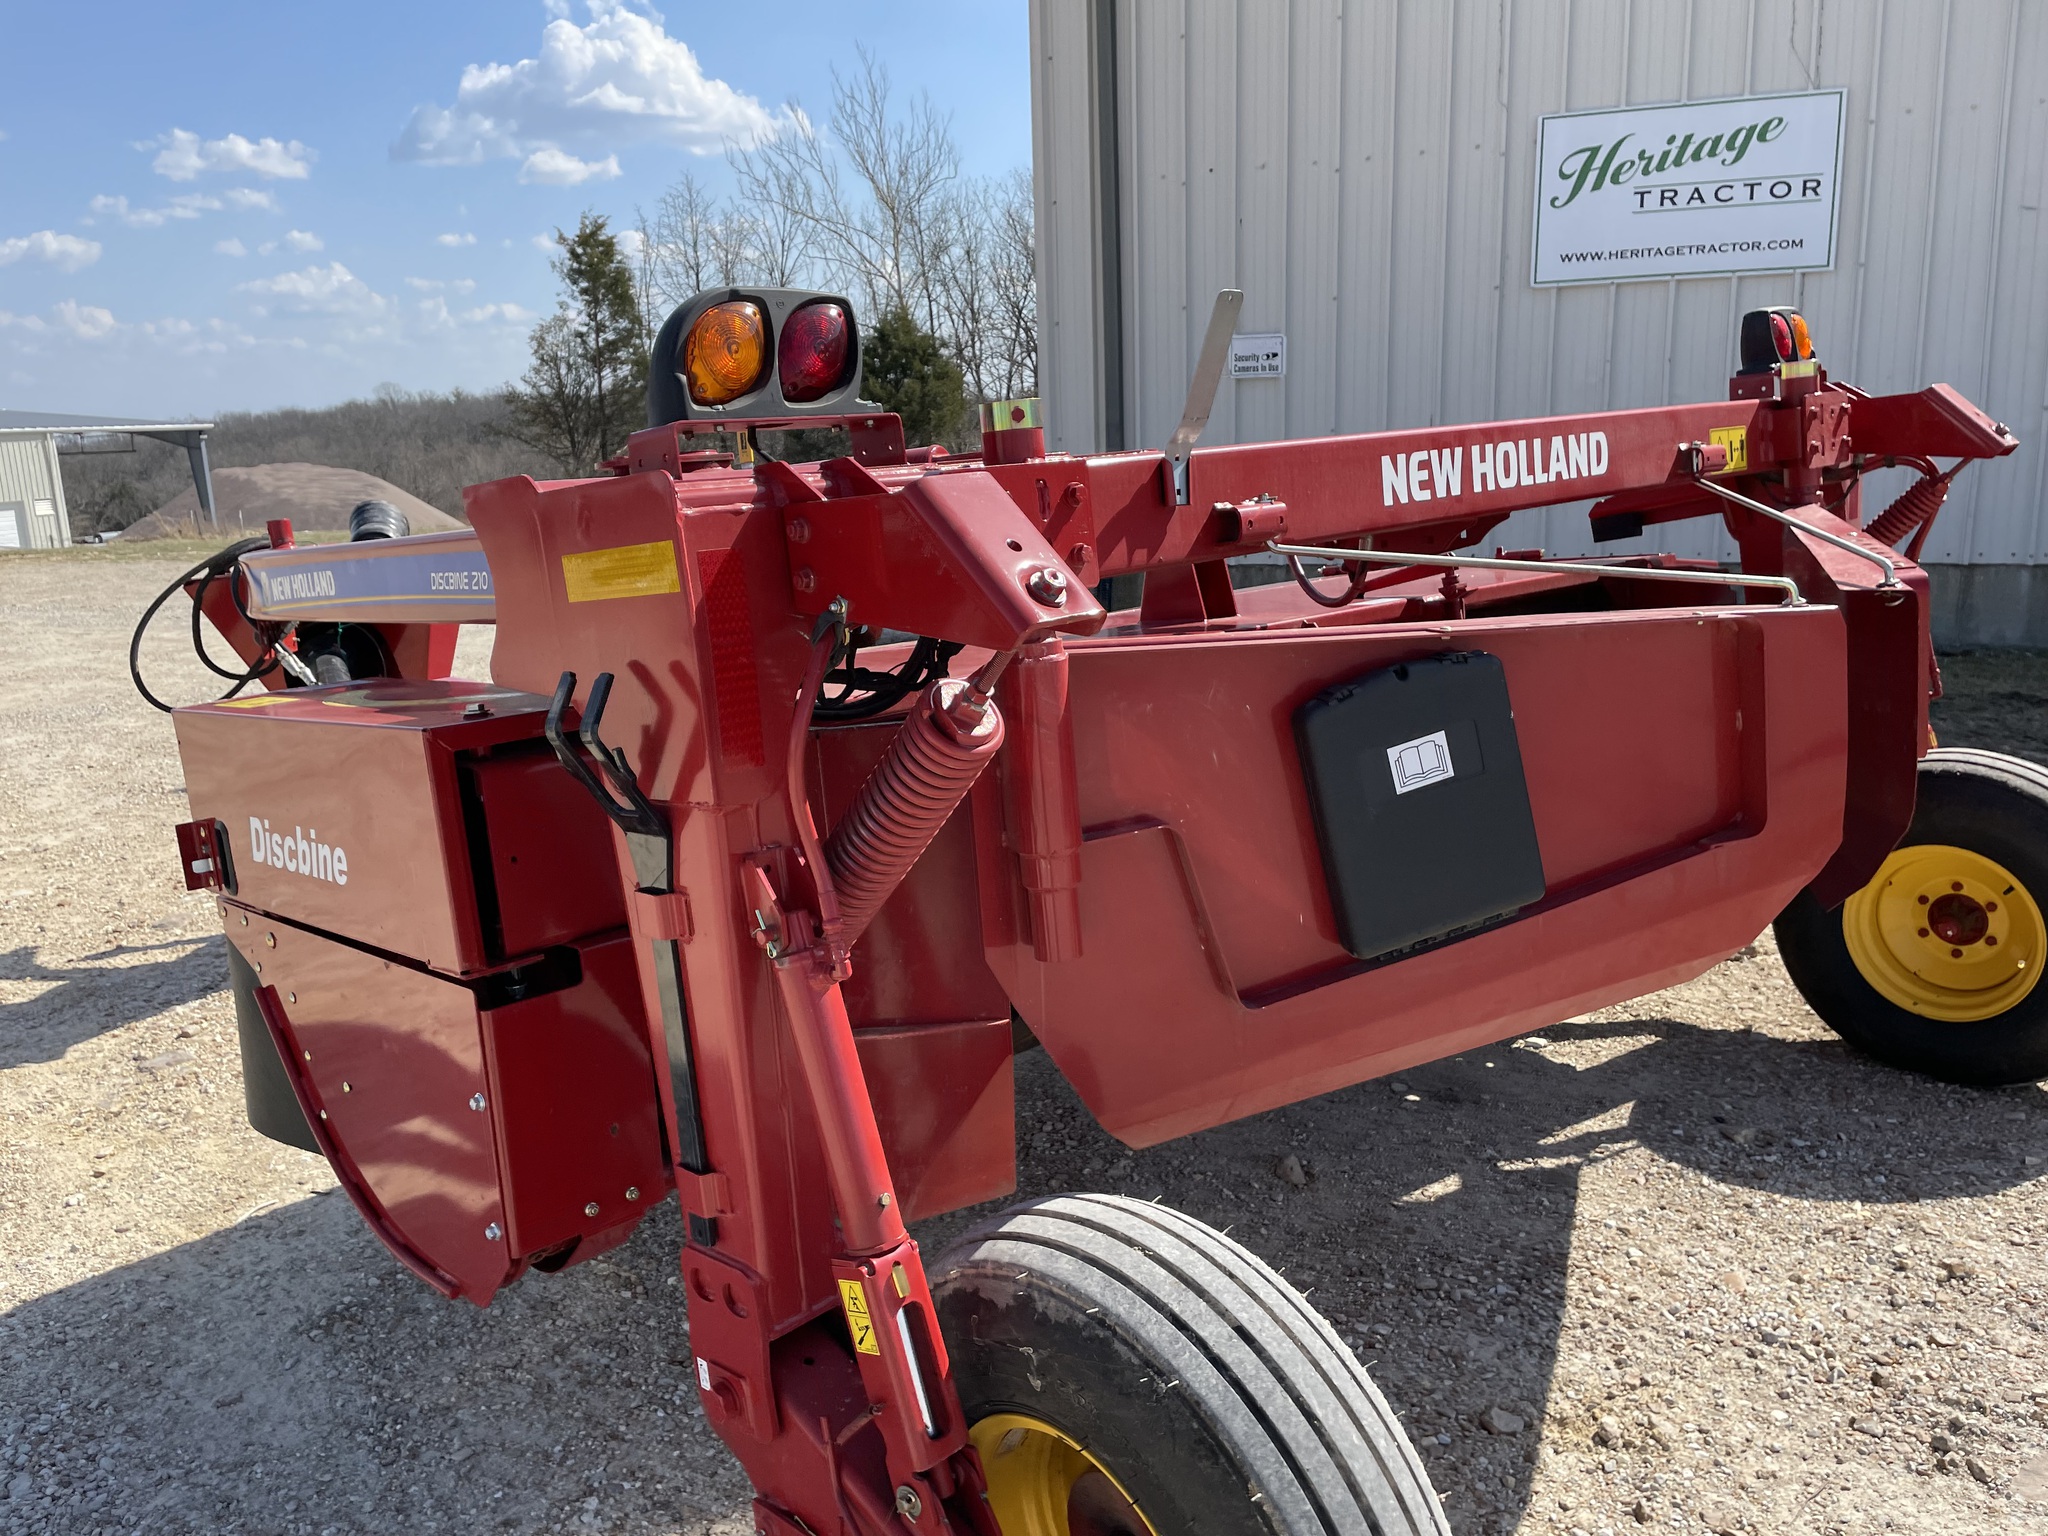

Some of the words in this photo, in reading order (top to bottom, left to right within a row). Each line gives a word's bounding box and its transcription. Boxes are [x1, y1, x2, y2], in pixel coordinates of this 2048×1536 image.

[1549, 115, 1789, 209] Heritage
[1633, 178, 1822, 209] TRACTOR
[1560, 238, 1804, 264] WWW.HERITAGETRACTOR.COM
[1234, 353, 1260, 363] Security
[1234, 364, 1259, 373] Cameras
[1261, 363, 1267, 372] In
[1268, 363, 1279, 372] Use
[1380, 446, 1463, 507] NEW
[1471, 431, 1609, 493] HOLLAND
[270, 576, 292, 602] NEW
[291, 570, 336, 599] HOLLAND
[430, 571, 469, 590] DISCBINE
[471, 571, 488, 590] 210
[249, 816, 348, 886] Discbine
